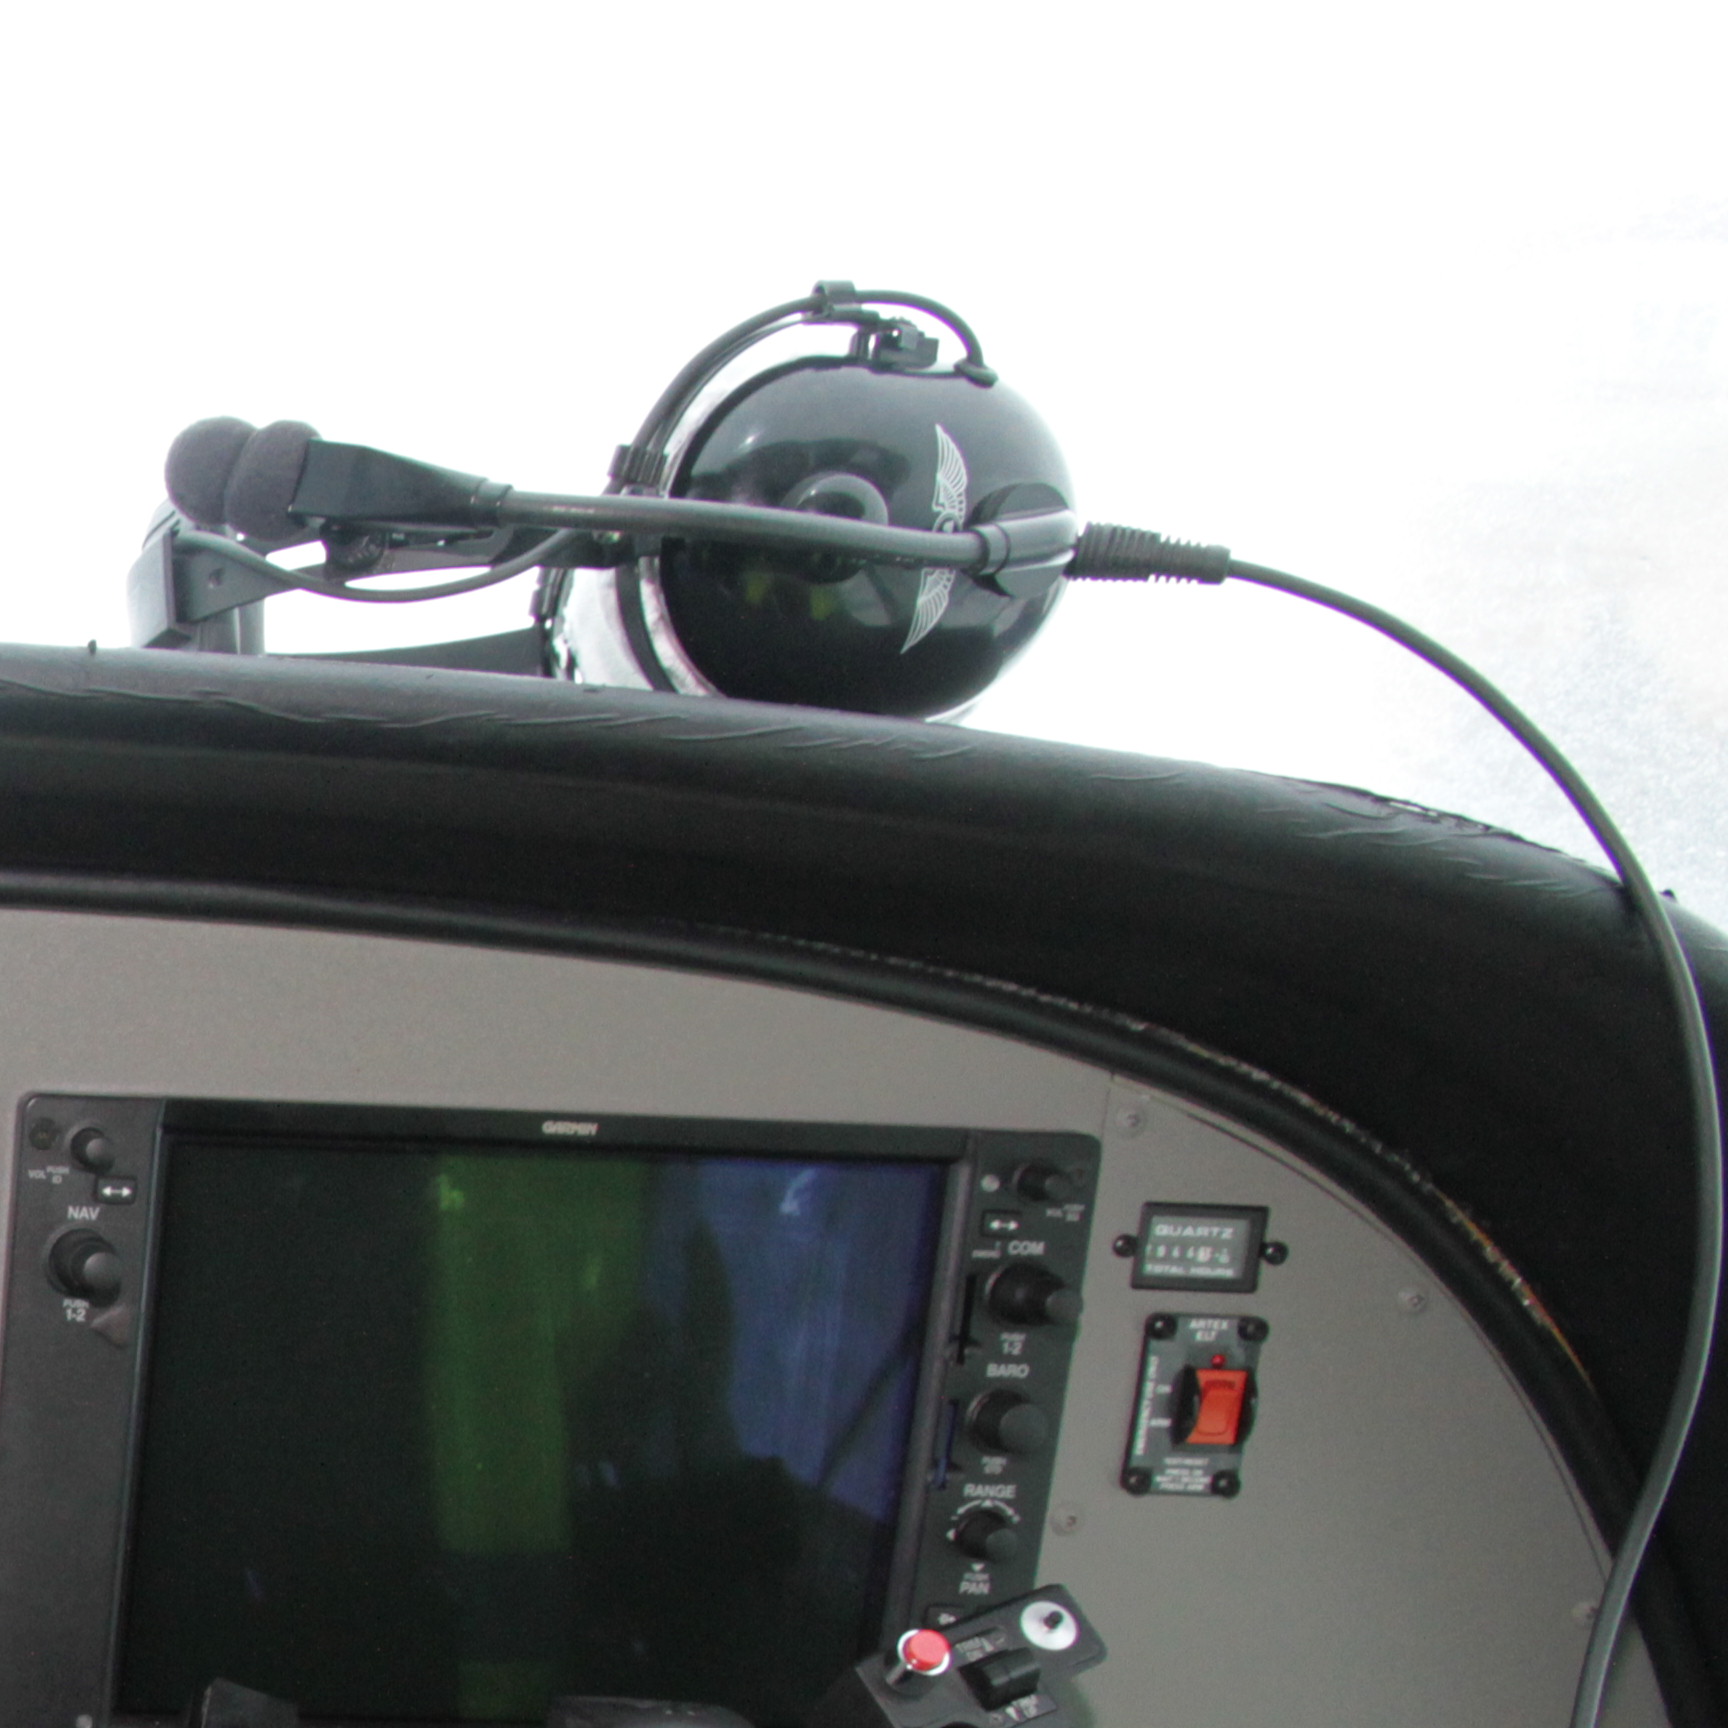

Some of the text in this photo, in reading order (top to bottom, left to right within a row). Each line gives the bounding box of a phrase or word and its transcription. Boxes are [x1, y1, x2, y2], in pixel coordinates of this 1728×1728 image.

[67, 1206, 99, 1220] NAV
[1155, 1224, 1234, 1238] QUARTZ
[987, 1364, 1029, 1378] BARO
[964, 1484, 1016, 1498] RANGE
